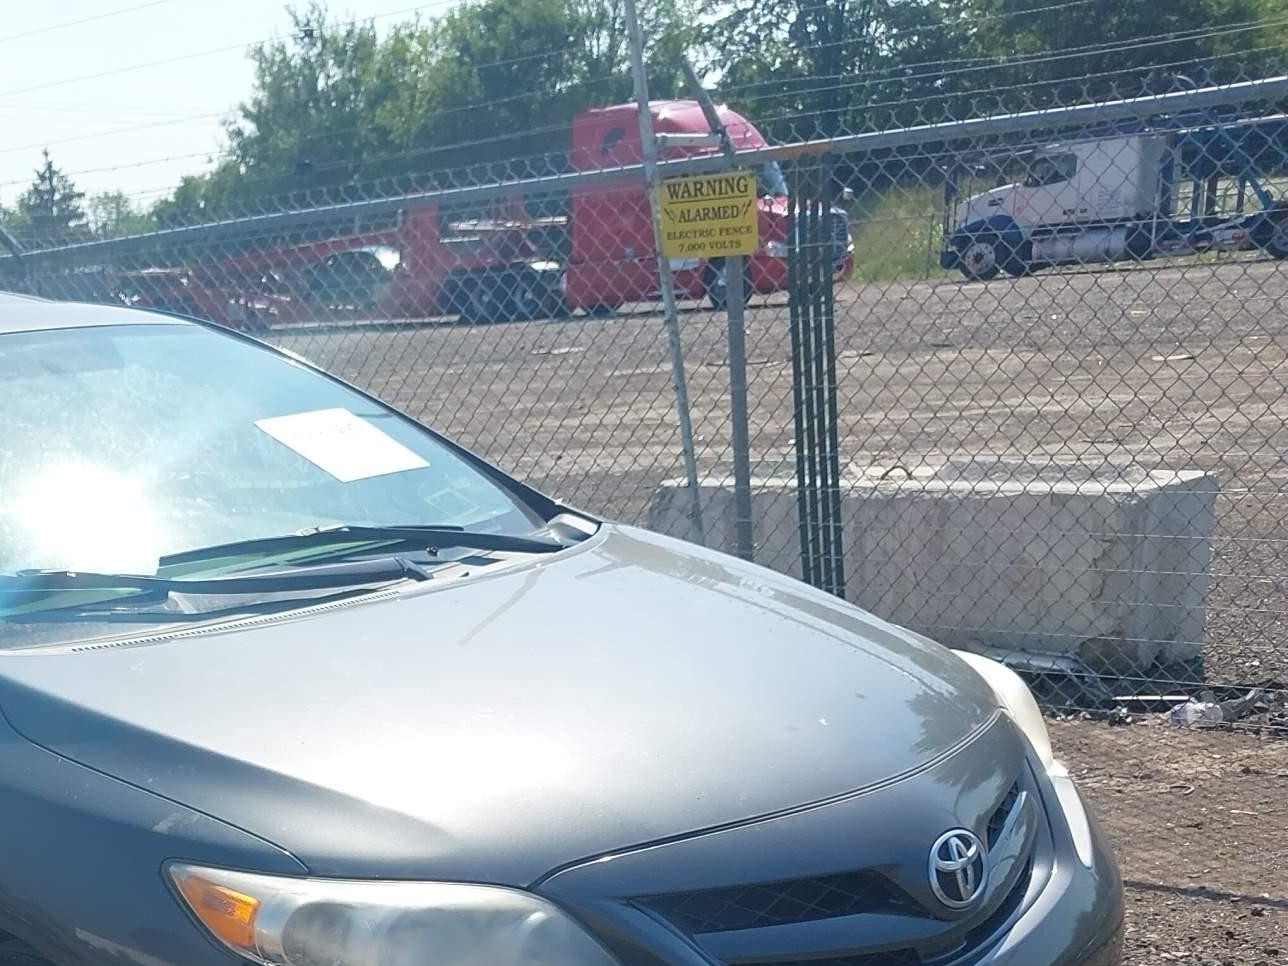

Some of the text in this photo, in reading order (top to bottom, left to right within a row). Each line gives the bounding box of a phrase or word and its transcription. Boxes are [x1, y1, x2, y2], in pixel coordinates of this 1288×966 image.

[666, 176, 748, 200] WARNING
[678, 205, 740, 224] ALARMED
[666, 225, 753, 241] ELECTRIC FENCE
[678, 240, 742, 253] 7,000 VOLTS
